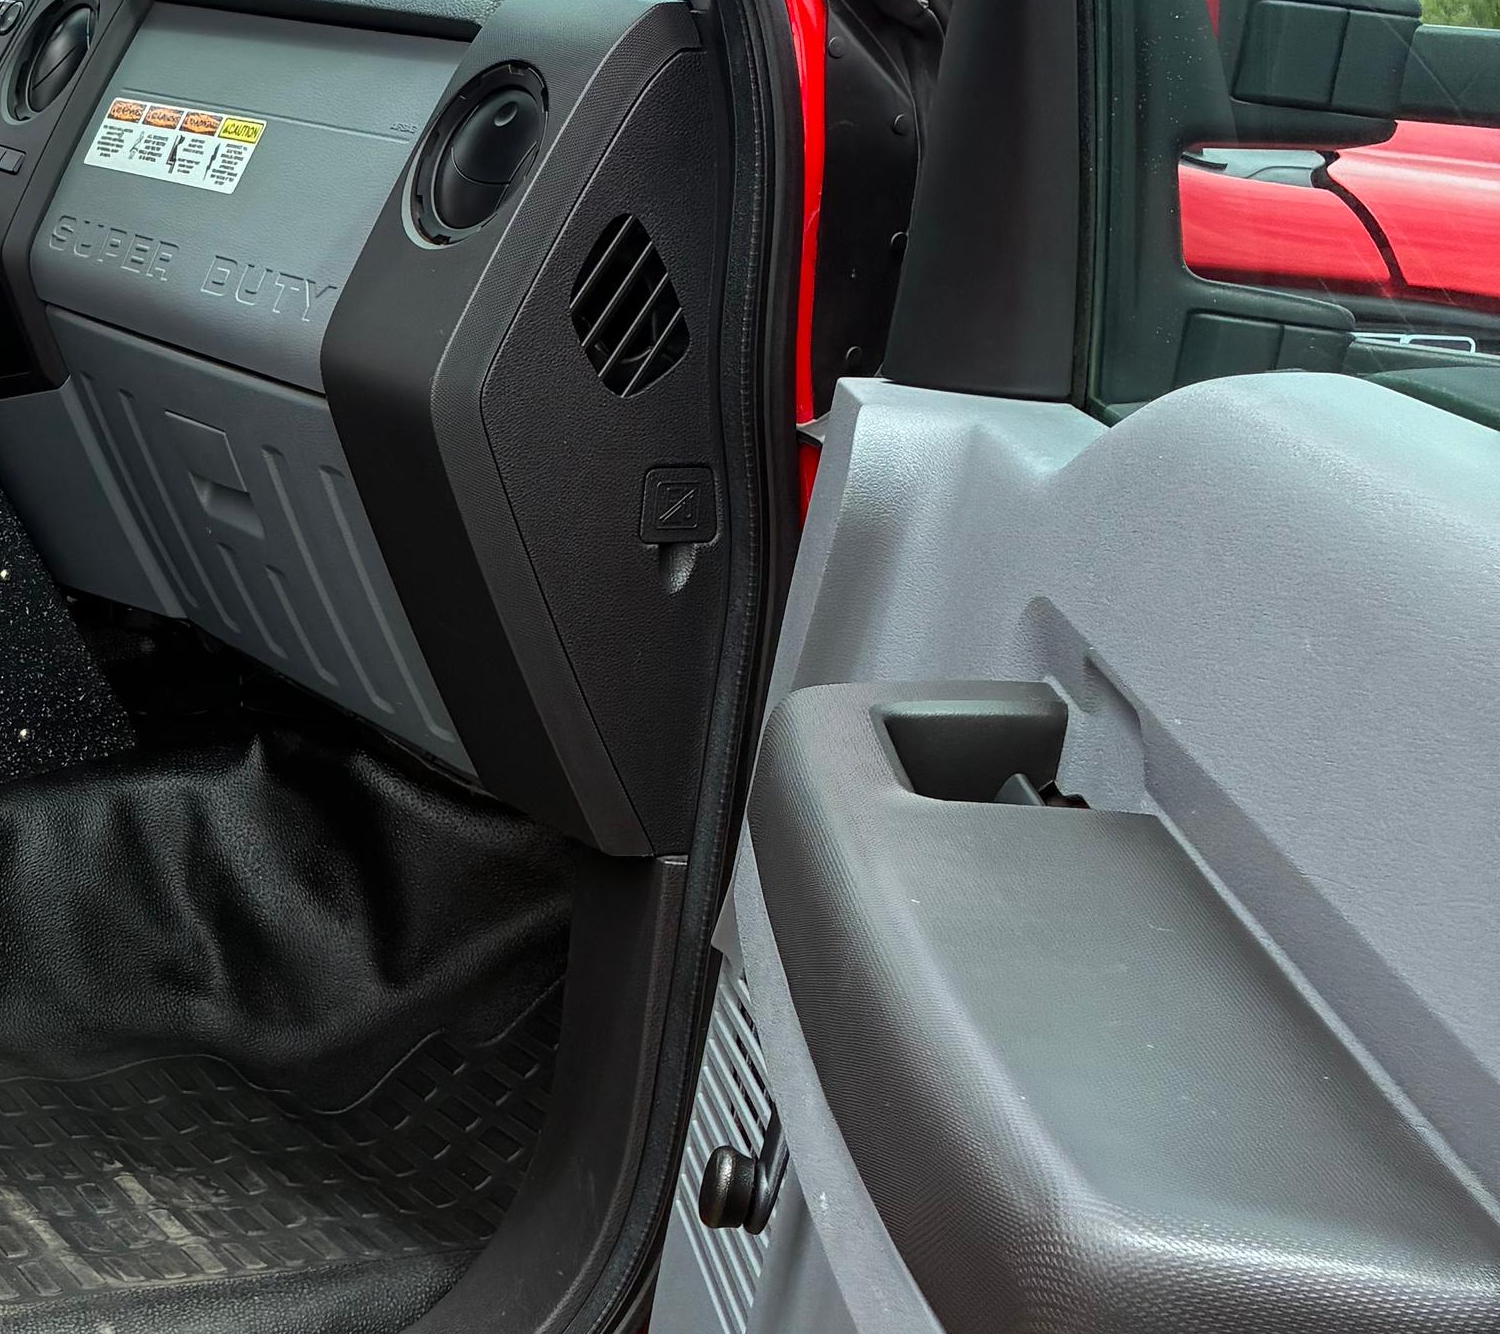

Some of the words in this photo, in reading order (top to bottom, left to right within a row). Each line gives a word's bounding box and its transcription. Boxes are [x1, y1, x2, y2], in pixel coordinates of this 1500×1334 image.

[228, 122, 258, 139] CAUTION
[50, 215, 180, 281] SUPER
[200, 255, 338, 323] DUTY
